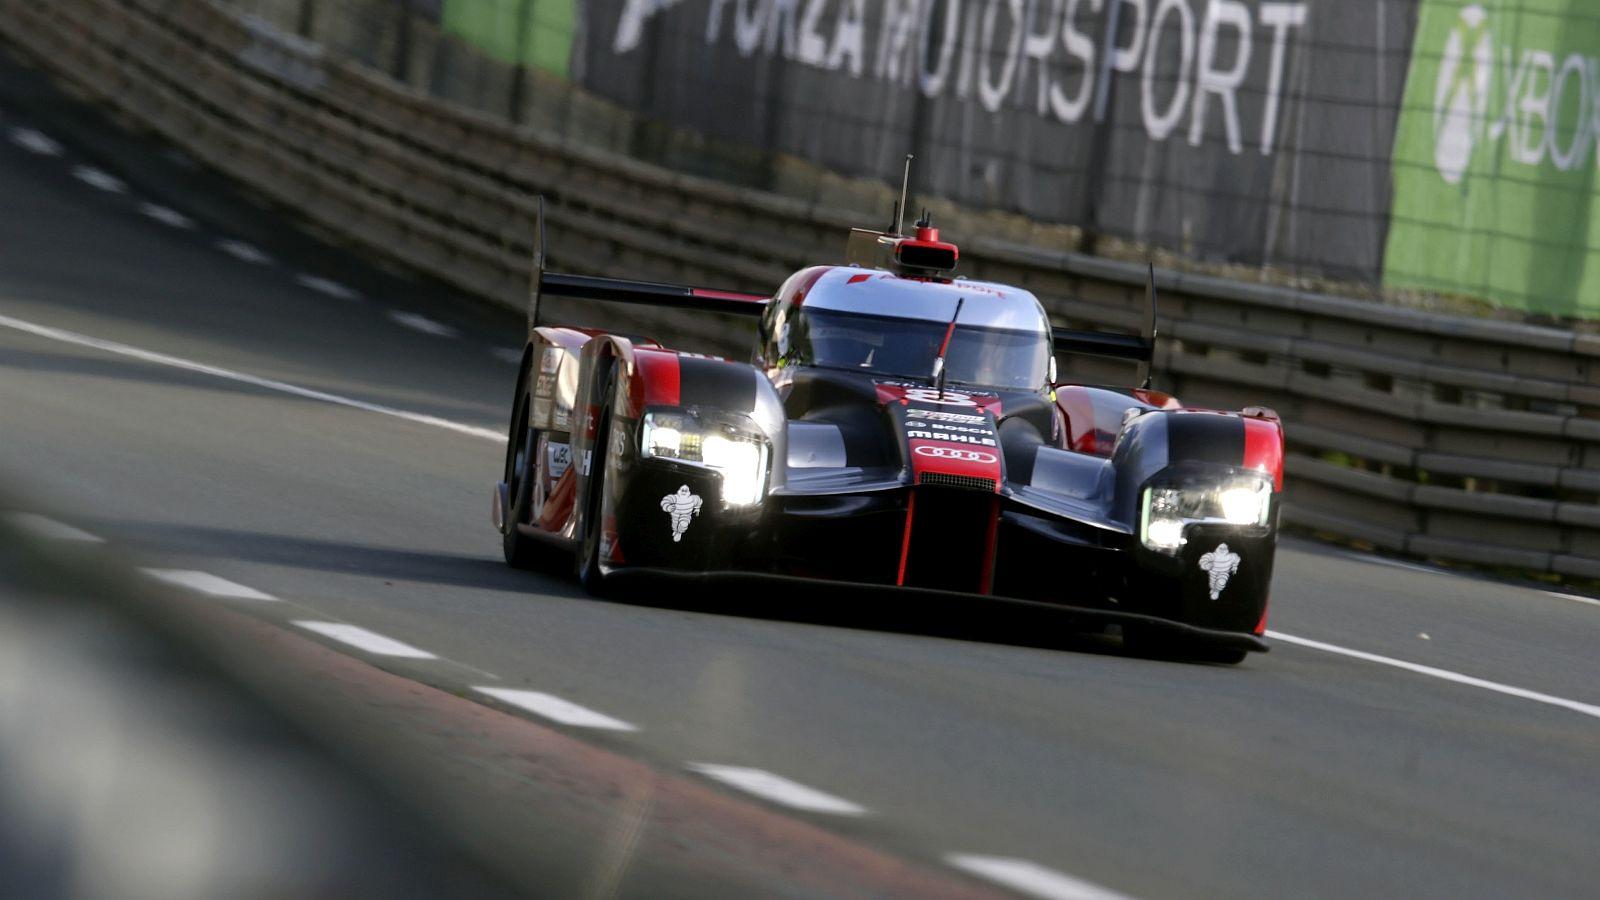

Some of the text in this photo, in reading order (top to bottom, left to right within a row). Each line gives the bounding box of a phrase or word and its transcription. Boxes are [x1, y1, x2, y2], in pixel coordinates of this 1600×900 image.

[873, 0, 1309, 156] MOTORSPORT
[904, 388, 978, 406] 8
[931, 423, 994, 435] BOSCH
[907, 430, 997, 446] MAHLE
